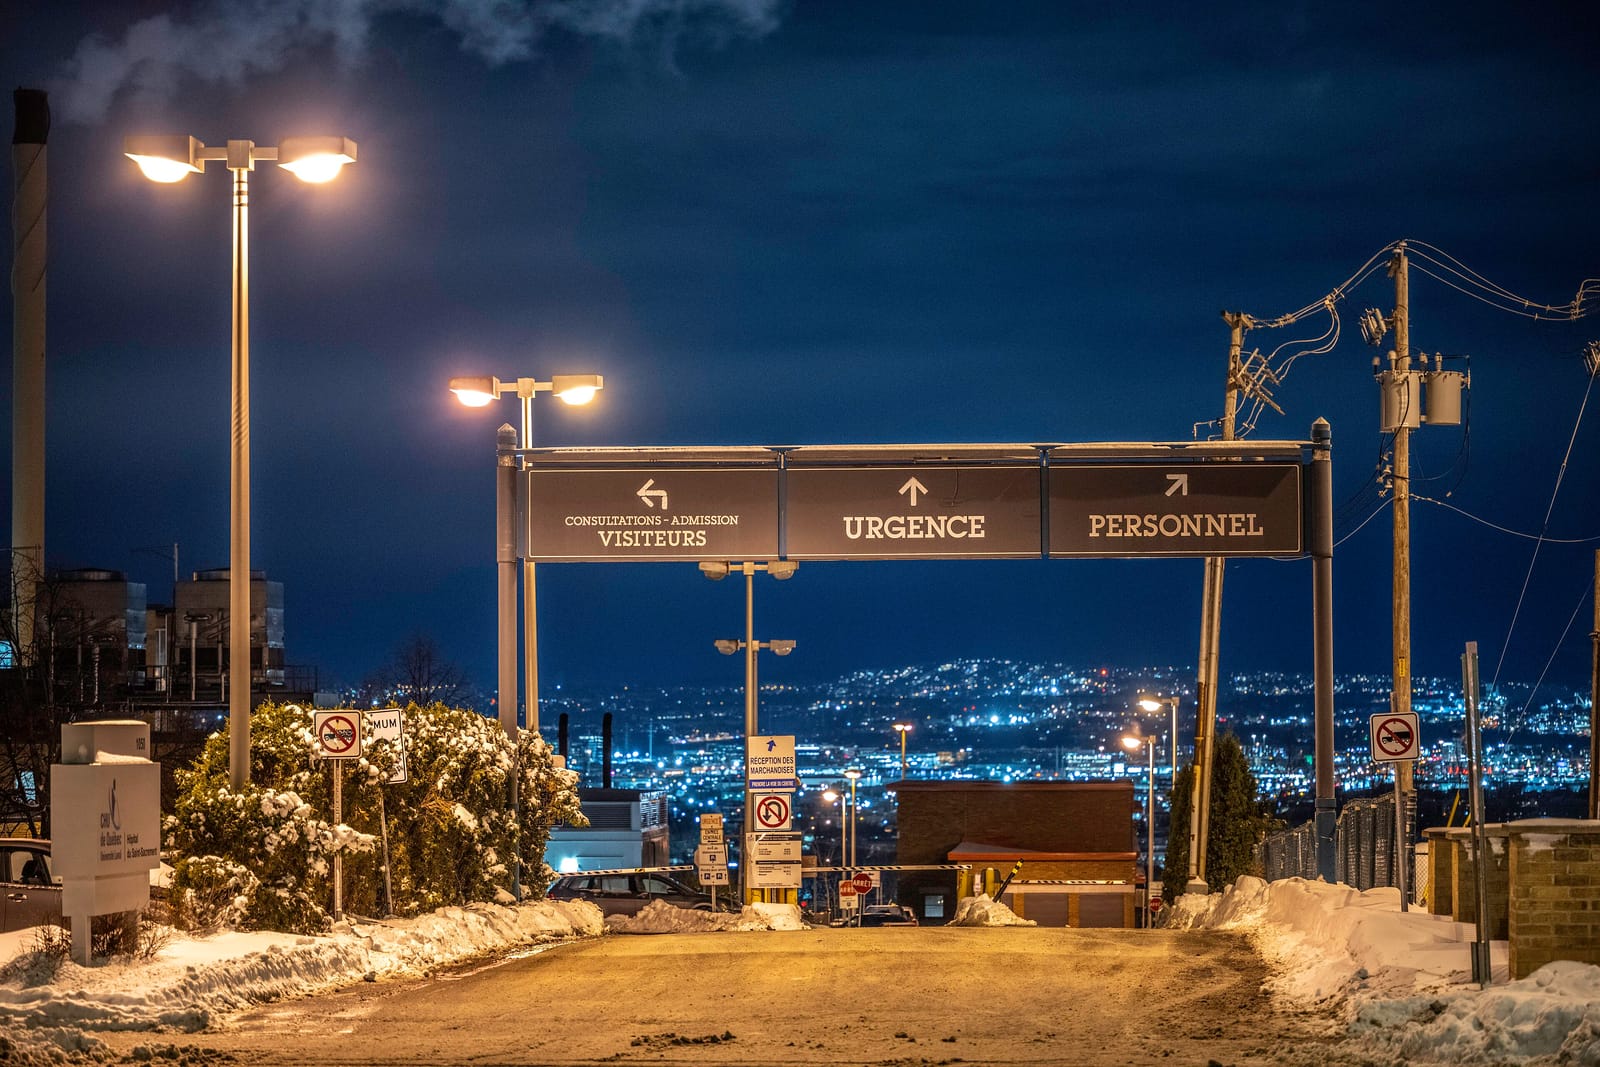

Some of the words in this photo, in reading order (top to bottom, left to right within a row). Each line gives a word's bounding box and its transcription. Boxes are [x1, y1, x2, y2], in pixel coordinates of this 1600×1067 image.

[565, 515, 662, 526] CONSULTATIONS
[671, 515, 739, 526] ADMISSION
[1088, 513, 1264, 537] PERSONNEL
[843, 515, 985, 539] URGENCE
[597, 530, 707, 547] VISITEURS
[782, 756, 794, 764] DES
[750, 766, 794, 775] MARCHANDISES
[853, 879, 871, 888] ARRÊT
